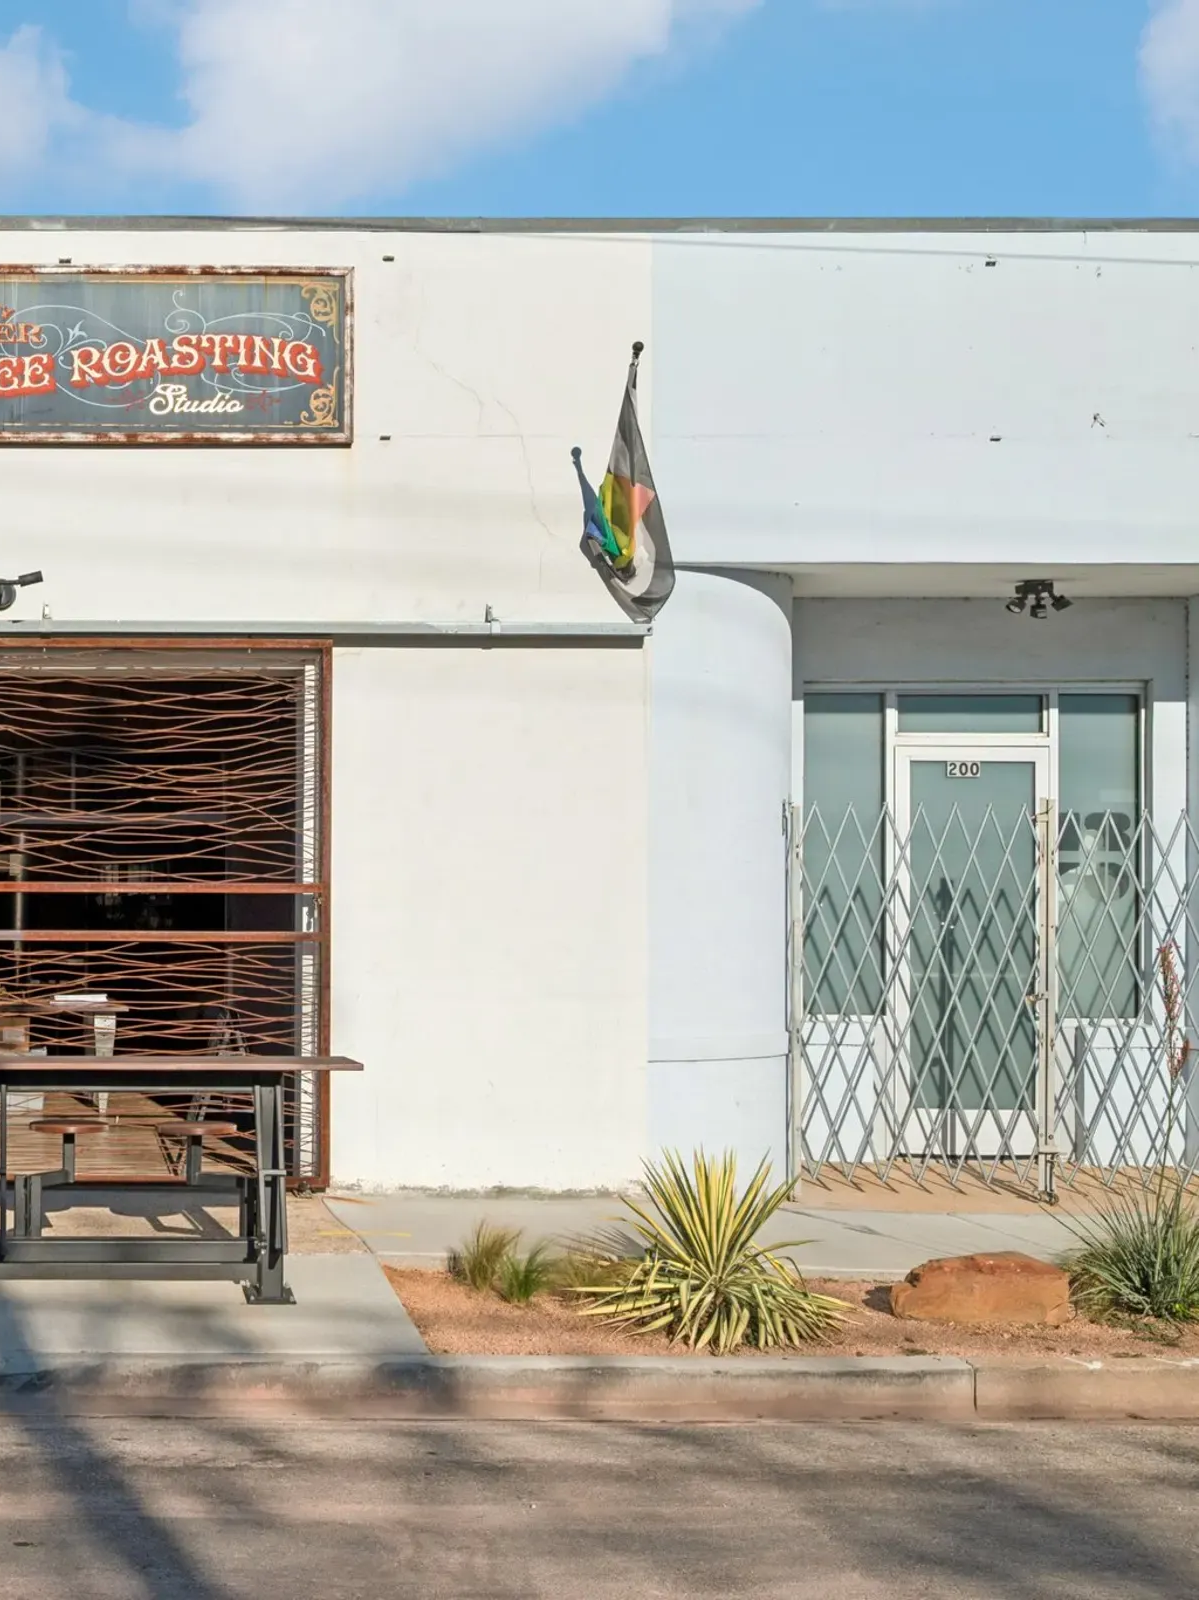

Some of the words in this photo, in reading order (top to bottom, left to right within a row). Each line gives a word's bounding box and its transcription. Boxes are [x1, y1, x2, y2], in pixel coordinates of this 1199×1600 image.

[69, 333, 325, 389] ROASTING
[149, 383, 245, 416] Studio
[948, 761, 980, 776] 200
